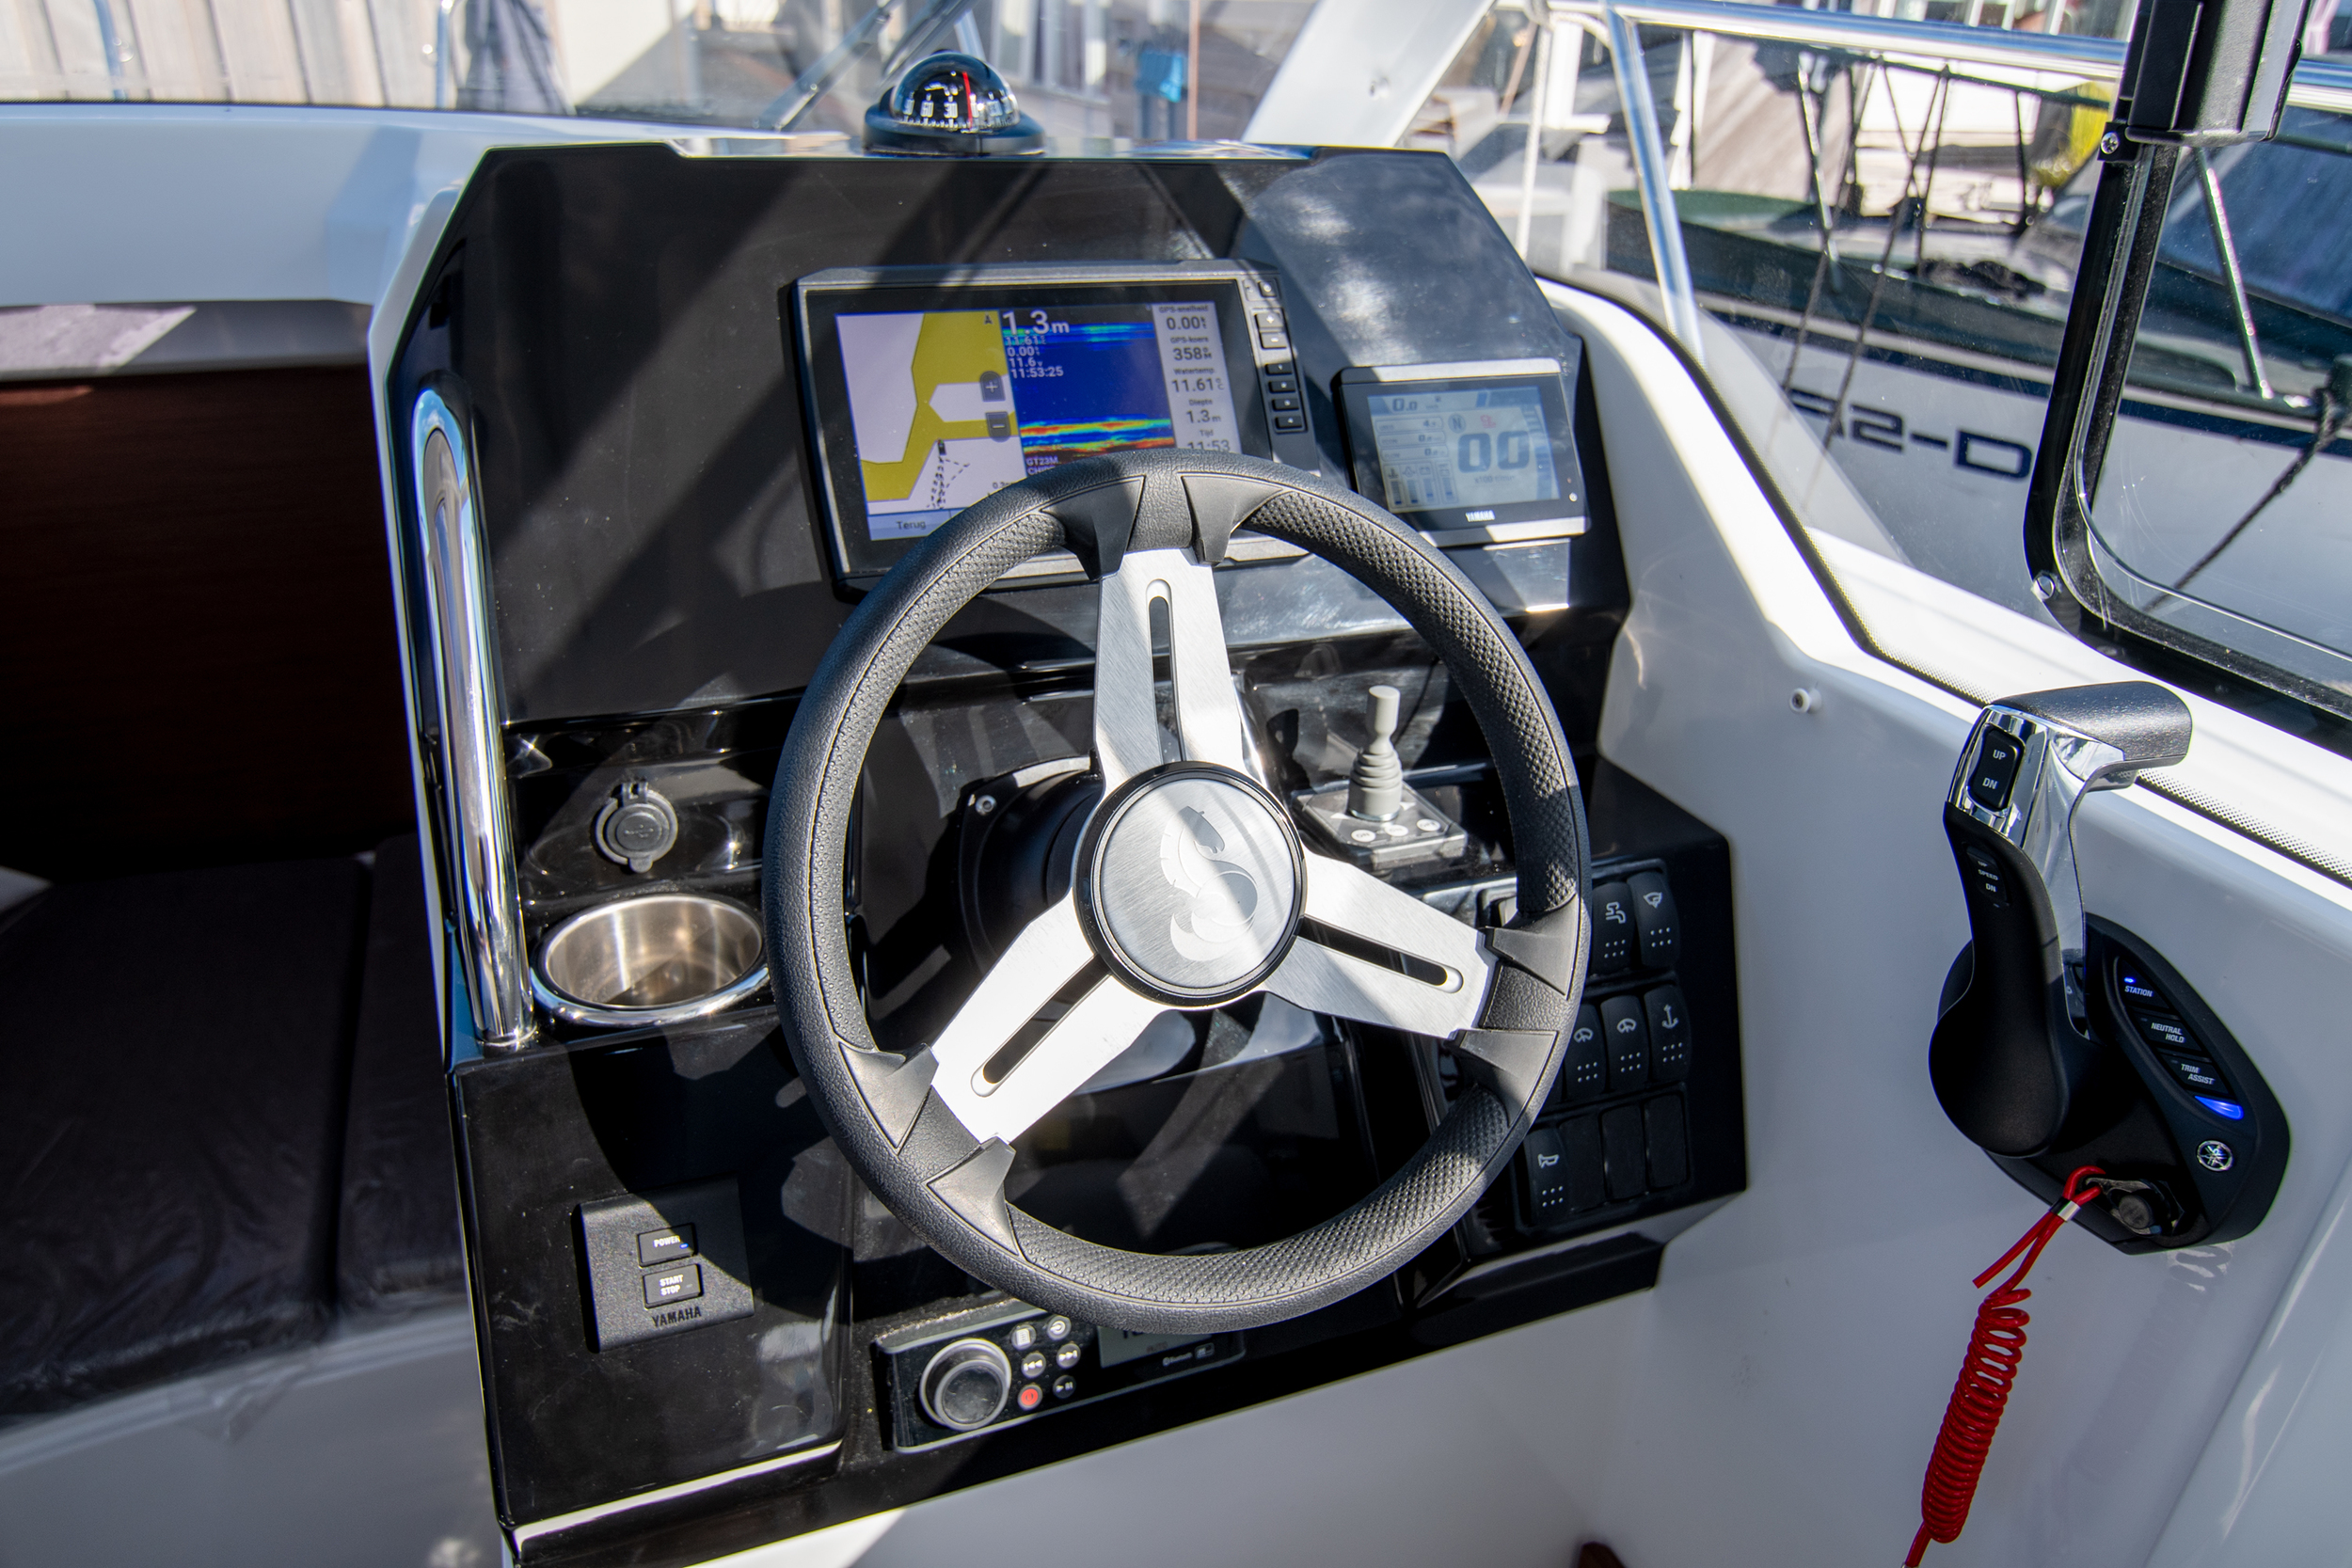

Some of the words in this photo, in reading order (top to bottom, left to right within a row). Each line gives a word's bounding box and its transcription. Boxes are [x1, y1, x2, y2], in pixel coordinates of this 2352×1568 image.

[1169, 335, 1210, 343] GPS-koers
[1010, 365, 1065, 379] 11:53:25
[1188, 398, 1214, 406] Diepte
[1200, 428, 1215, 437] Tijd
[1025, 456, 1059, 467] GT23M
[1466, 510, 1495, 522] YAMAHA
[896, 520, 927, 531] Terug
[1993, 749, 2007, 761] UP
[1982, 777, 1998, 790] DN
[1978, 869, 1999, 880] SPEED
[1985, 882, 1996, 893] DN
[2124, 985, 2153, 997] STATION
[2151, 1022, 2183, 1036] NEUTRAL
[2165, 1033, 2185, 1043] HOLD
[2181, 1063, 2200, 1073] TRIM
[2187, 1073, 2216, 1085] ASSIST
[653, 1235, 681, 1248] POWER
[660, 1274, 684, 1287] START
[660, 1285, 681, 1297] STOP
[652, 1306, 702, 1327] YAMAHA
